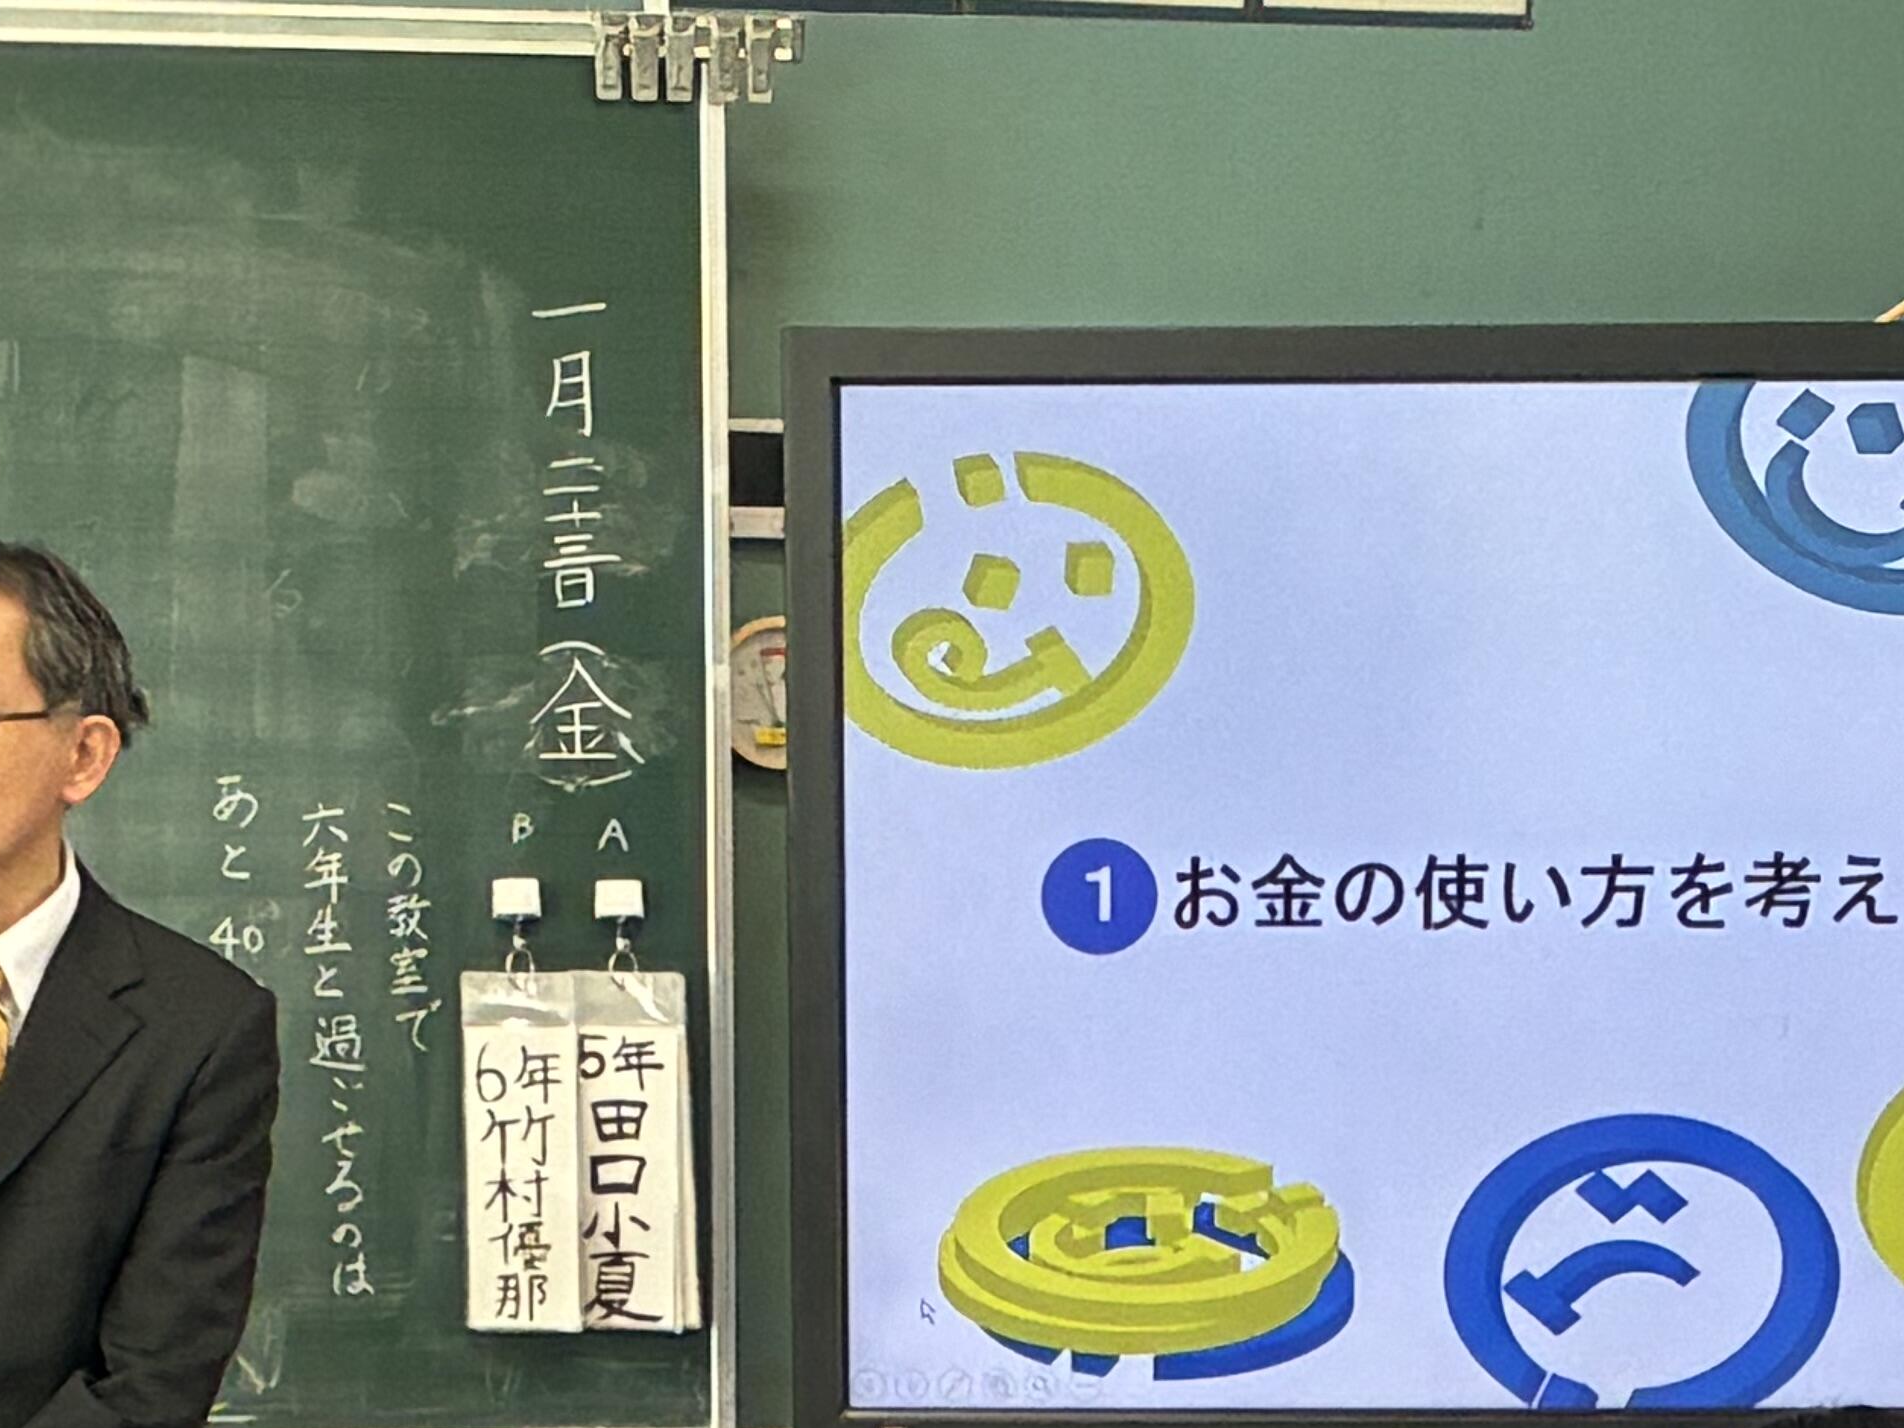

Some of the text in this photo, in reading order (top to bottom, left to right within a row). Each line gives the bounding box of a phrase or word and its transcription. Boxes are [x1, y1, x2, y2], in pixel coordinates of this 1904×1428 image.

[511, 812, 535, 845] B
[597, 817, 630, 853] A
[386, 802, 443, 1054] この教室で
[302, 802, 376, 1297] 六年生と過ごせるのは
